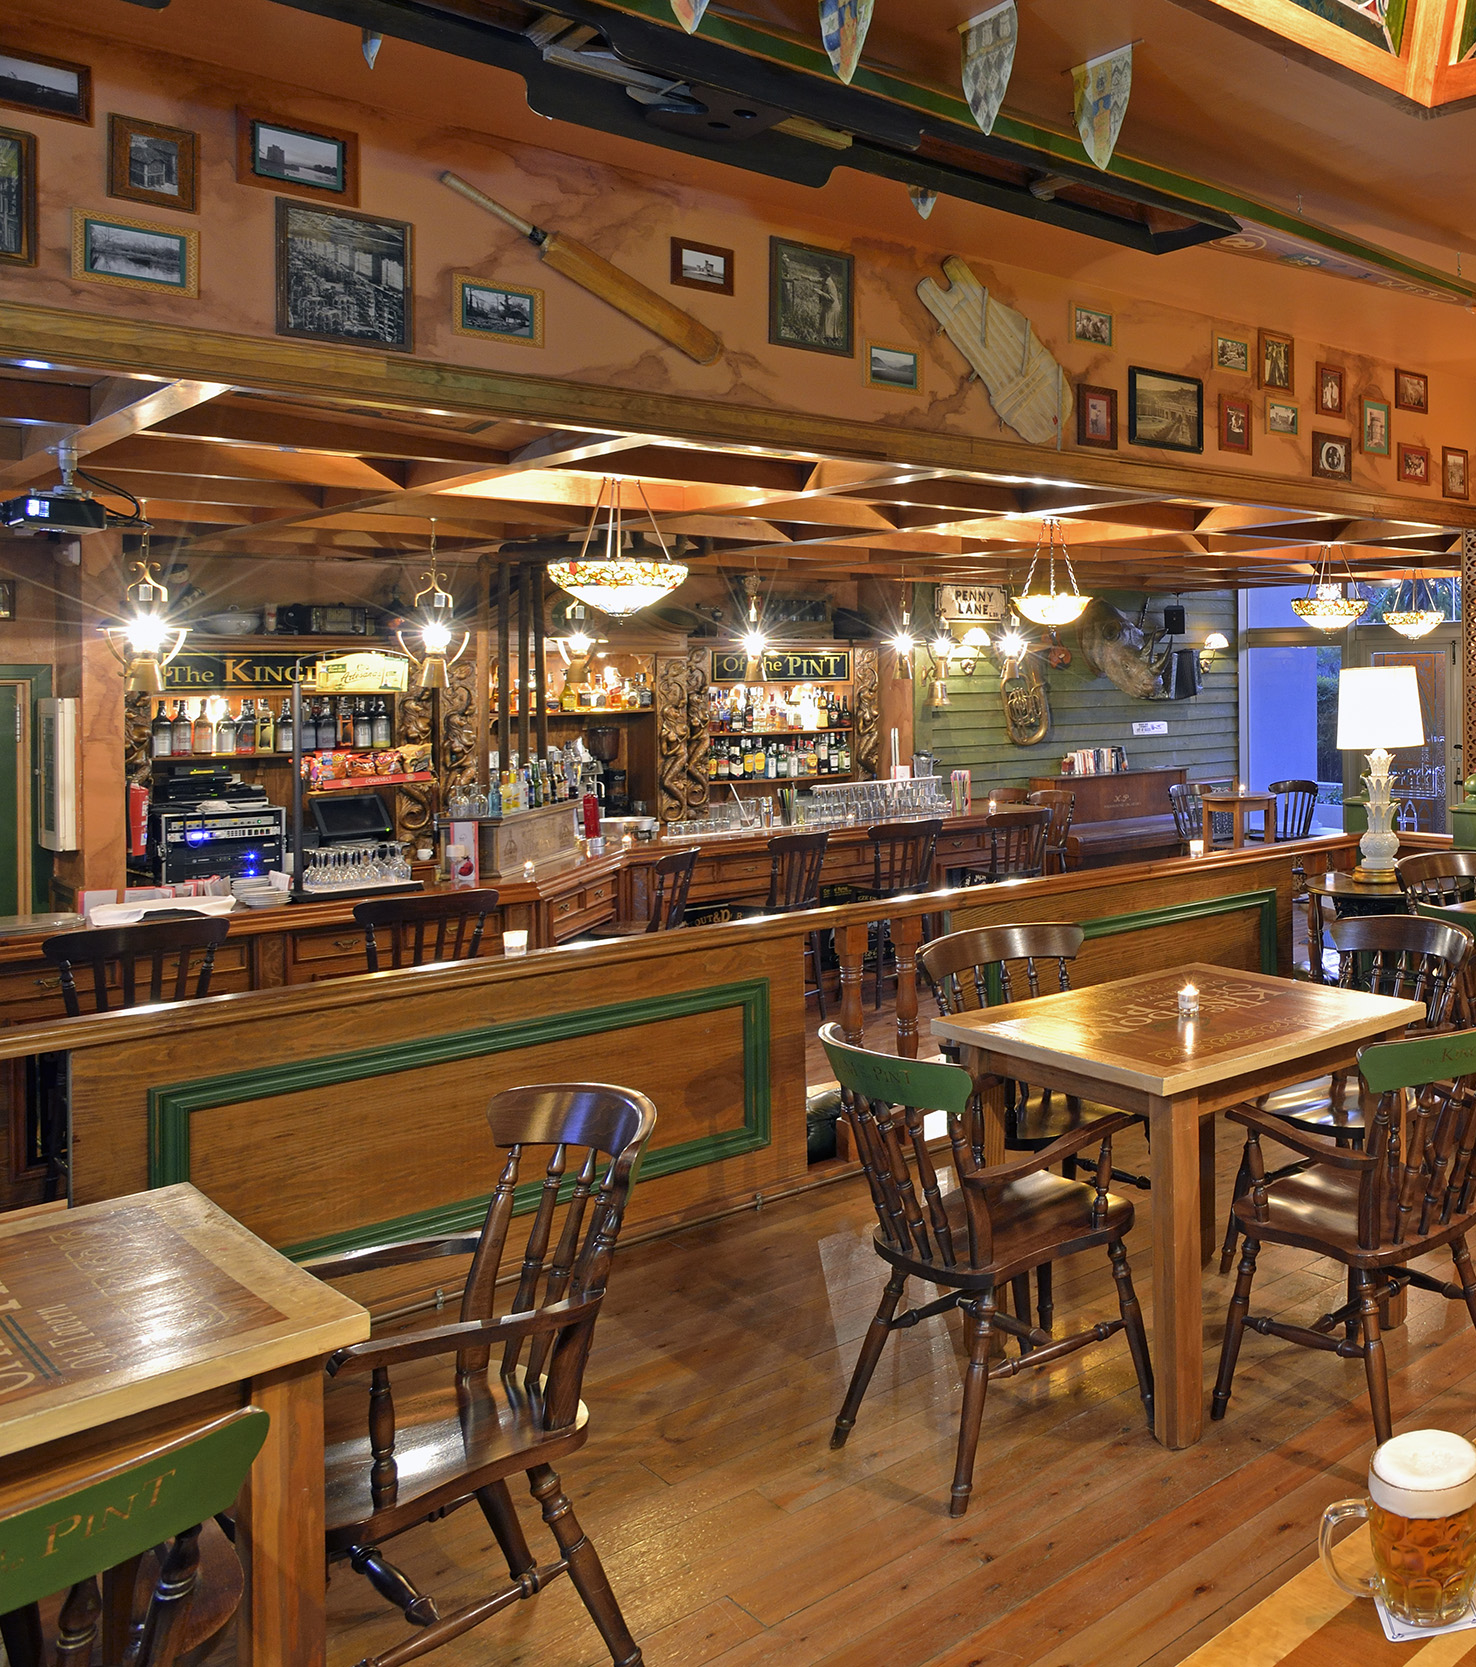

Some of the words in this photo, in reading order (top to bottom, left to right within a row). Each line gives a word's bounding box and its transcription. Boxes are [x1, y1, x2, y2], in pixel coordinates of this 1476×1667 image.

[955, 590, 994, 603] PENNY
[957, 603, 989, 615] LANE
[167, 665, 215, 683] The
[222, 659, 317, 683] KINGD
[723, 656, 745, 672] Of
[787, 655, 840, 676] PINT
[873, 1065, 912, 1086] PINT
[57, 1341, 119, 1370] Old
[40, 1469, 177, 1559] PINT
